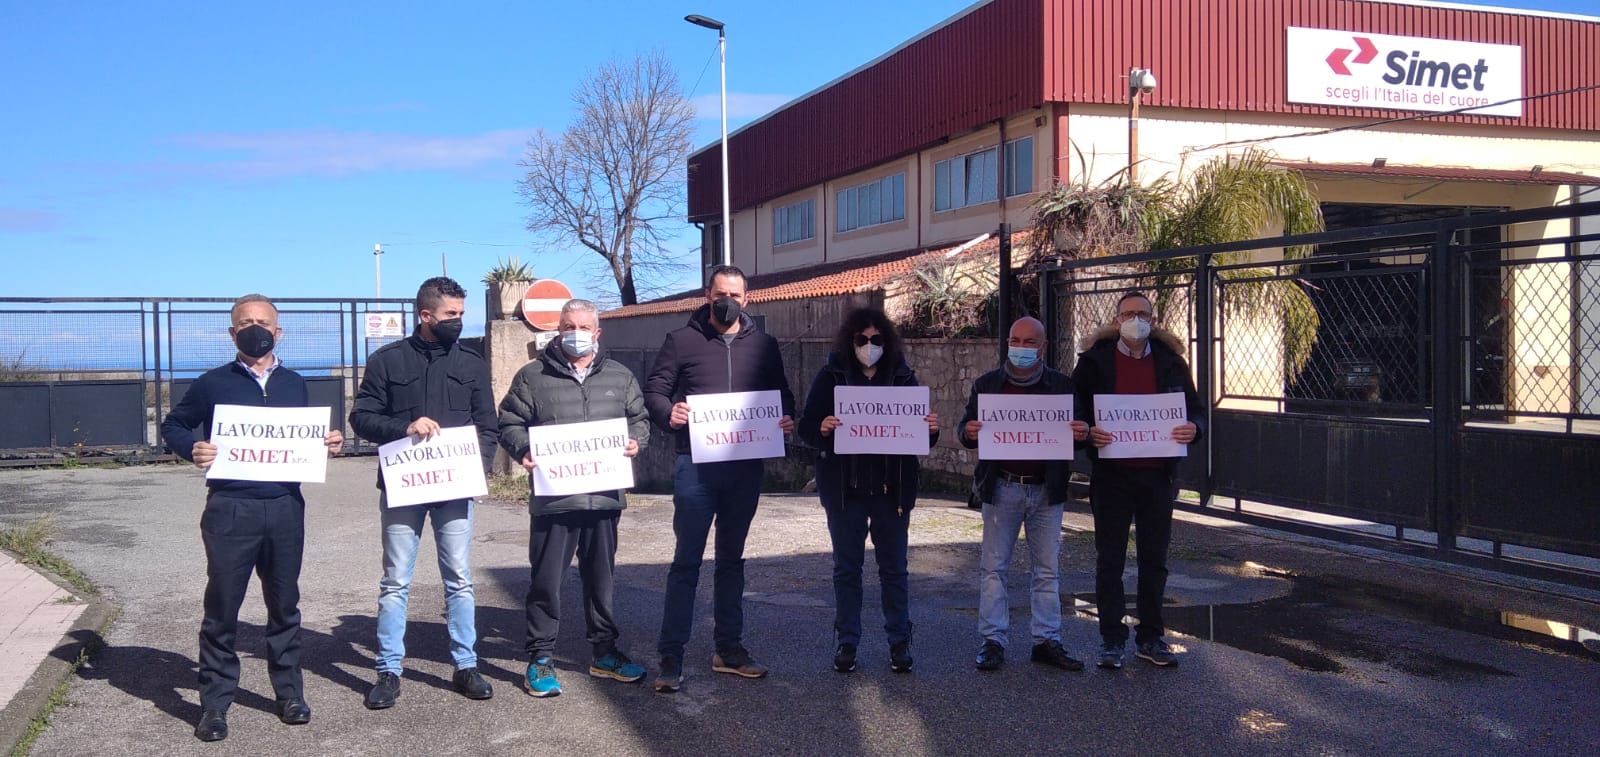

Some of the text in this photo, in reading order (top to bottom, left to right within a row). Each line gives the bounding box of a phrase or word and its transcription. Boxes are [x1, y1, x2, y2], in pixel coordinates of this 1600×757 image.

[1382, 50, 1489, 91] Simet
[1326, 86, 1369, 103] scegli
[1423, 91, 1444, 105] del
[1449, 95, 1489, 107] cuore
[692, 405, 780, 423] LAVORATORI
[839, 402, 926, 416] LAVORATORI
[981, 409, 1070, 422] LAVORATORI
[1098, 408, 1184, 421] LAVORATORI
[216, 422, 327, 439] LAVORATORI
[706, 429, 756, 446] SIMET
[849, 425, 901, 438] SIMET
[993, 431, 1045, 444] SIMET
[1111, 430, 1159, 443] SIMET
[535, 434, 626, 457] LAVORATORI
[228, 448, 294, 463] SIMET
[384, 442, 477, 467] LAVORATORI
[401, 468, 456, 488] SIMET
[549, 461, 602, 480] SIMET
